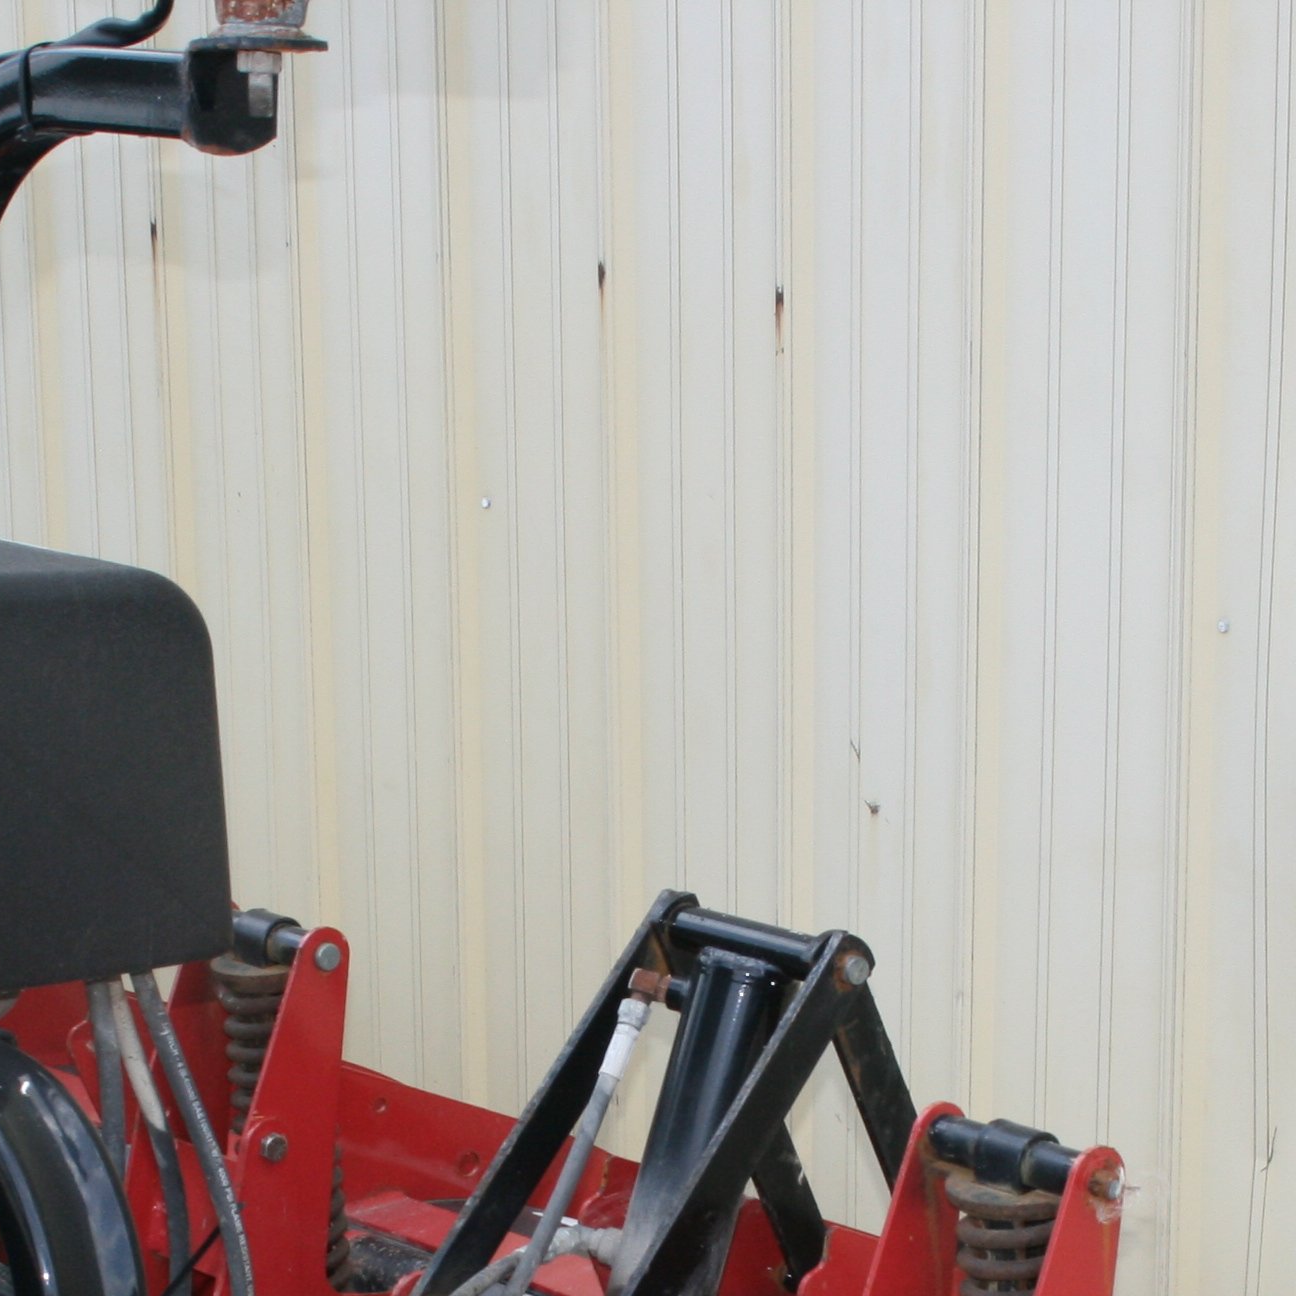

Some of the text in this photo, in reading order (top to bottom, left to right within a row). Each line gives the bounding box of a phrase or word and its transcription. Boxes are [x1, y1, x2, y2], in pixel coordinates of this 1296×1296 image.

[192, 1100, 205, 1120] SAE
[217, 1167, 230, 1187] 4000
[224, 1187, 235, 1203] PSI
[229, 1203, 245, 1234] FLAME
